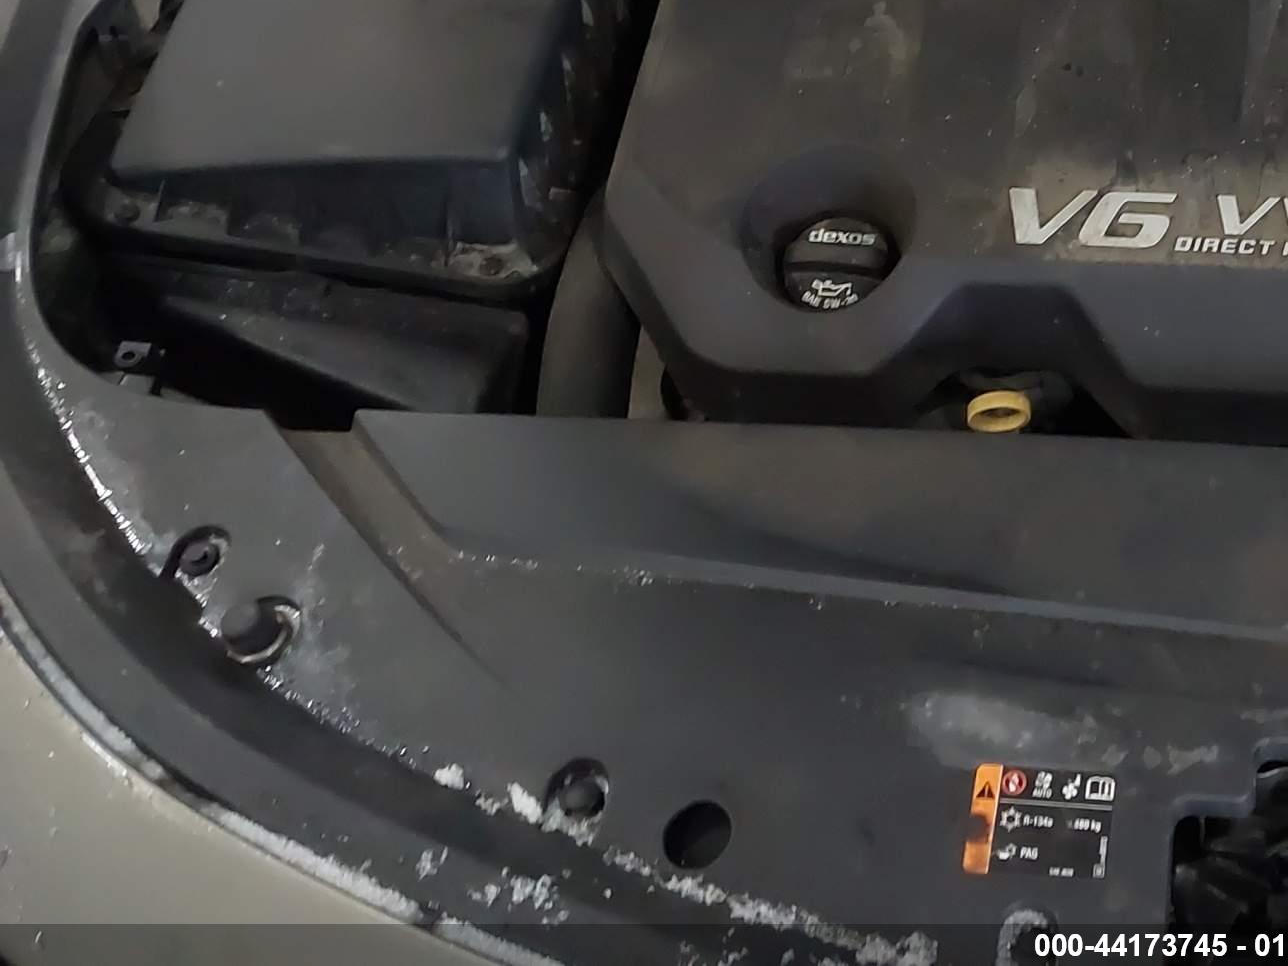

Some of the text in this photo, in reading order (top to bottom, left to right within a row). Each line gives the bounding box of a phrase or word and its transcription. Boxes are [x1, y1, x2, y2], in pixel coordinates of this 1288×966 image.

[1008, 186, 1179, 250] V6
[808, 228, 877, 246] dexos
[1174, 236, 1276, 257] DIRECT
[1019, 846, 1039, 861] PAG
